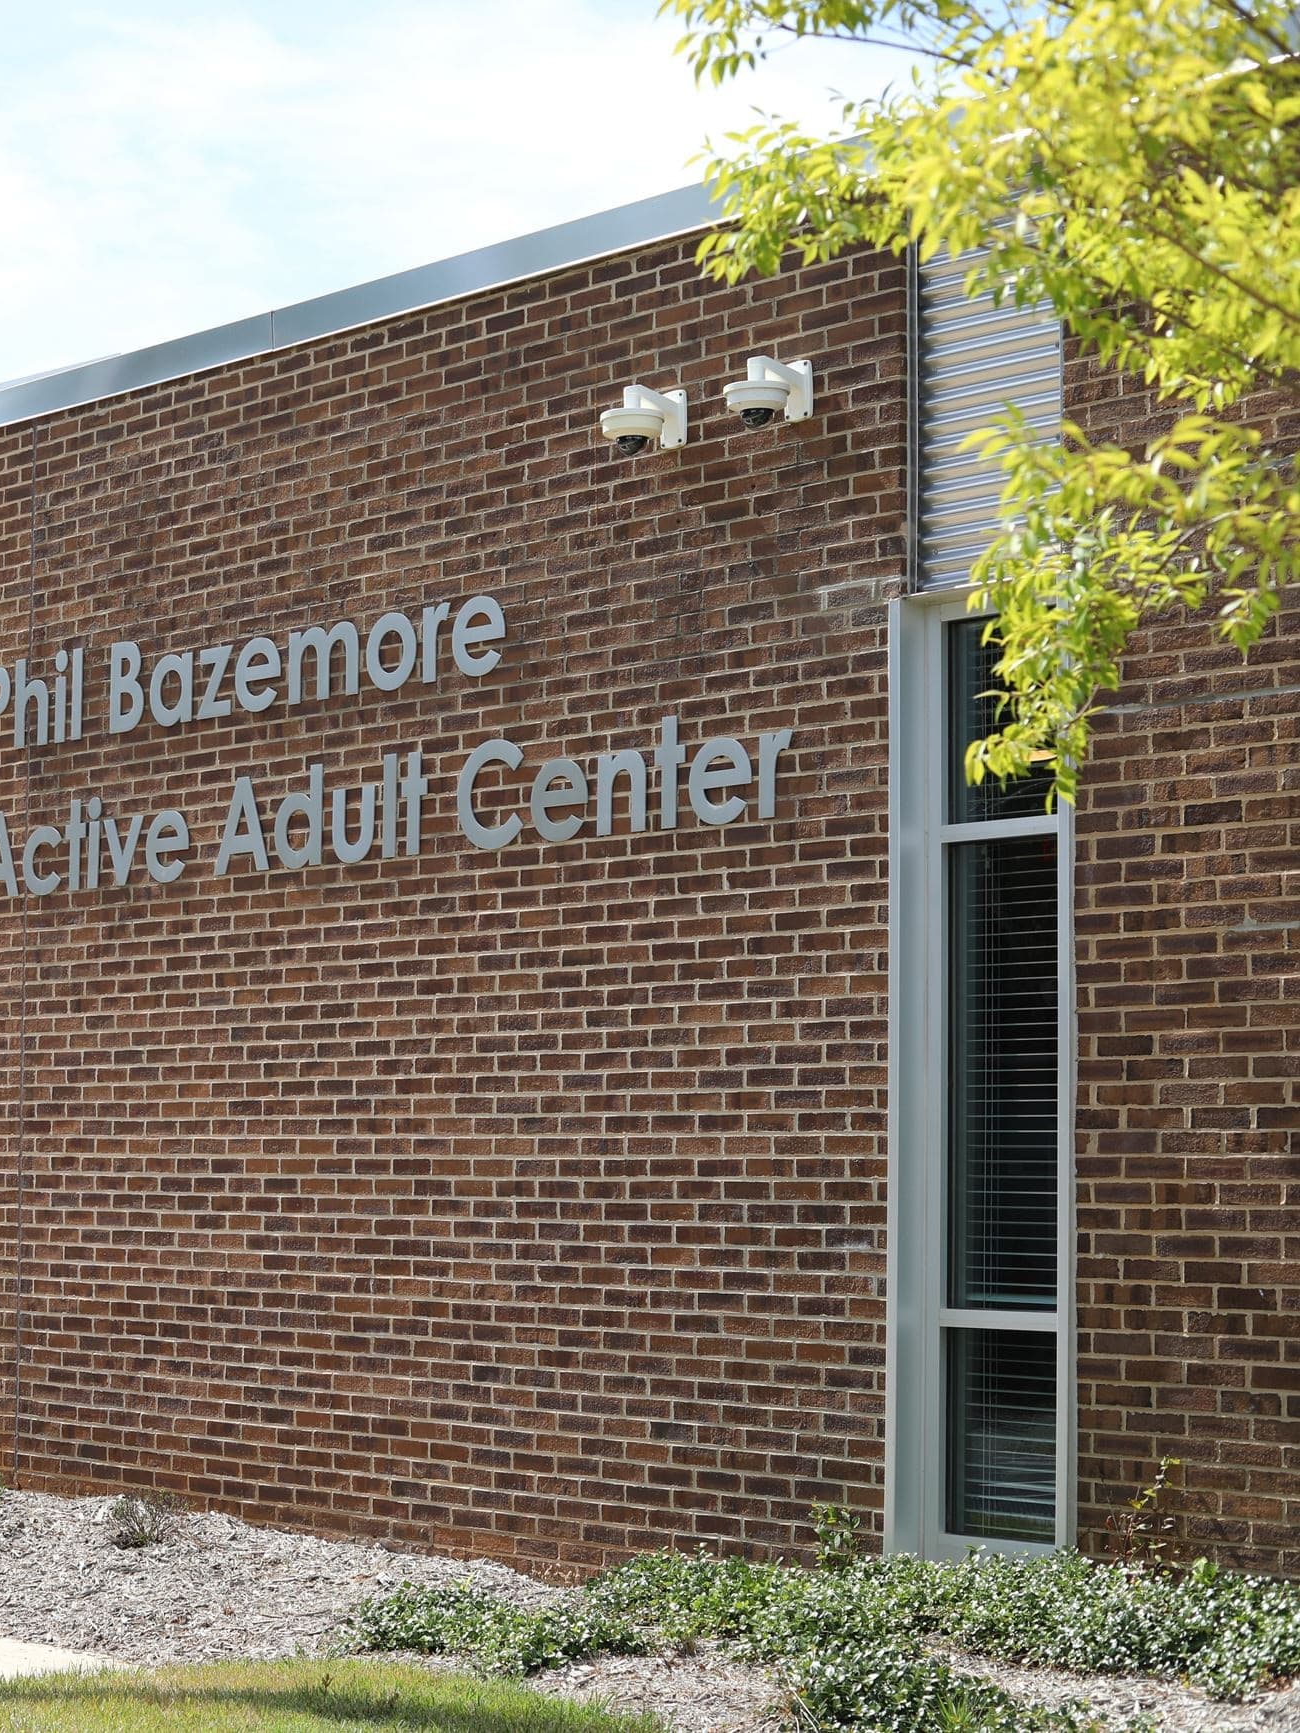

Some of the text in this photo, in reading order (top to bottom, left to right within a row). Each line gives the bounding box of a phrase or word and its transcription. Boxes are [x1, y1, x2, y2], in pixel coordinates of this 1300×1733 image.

[108, 595, 506, 734] Bazemore
[215, 751, 428, 876] Adult
[456, 715, 793, 850] Center
